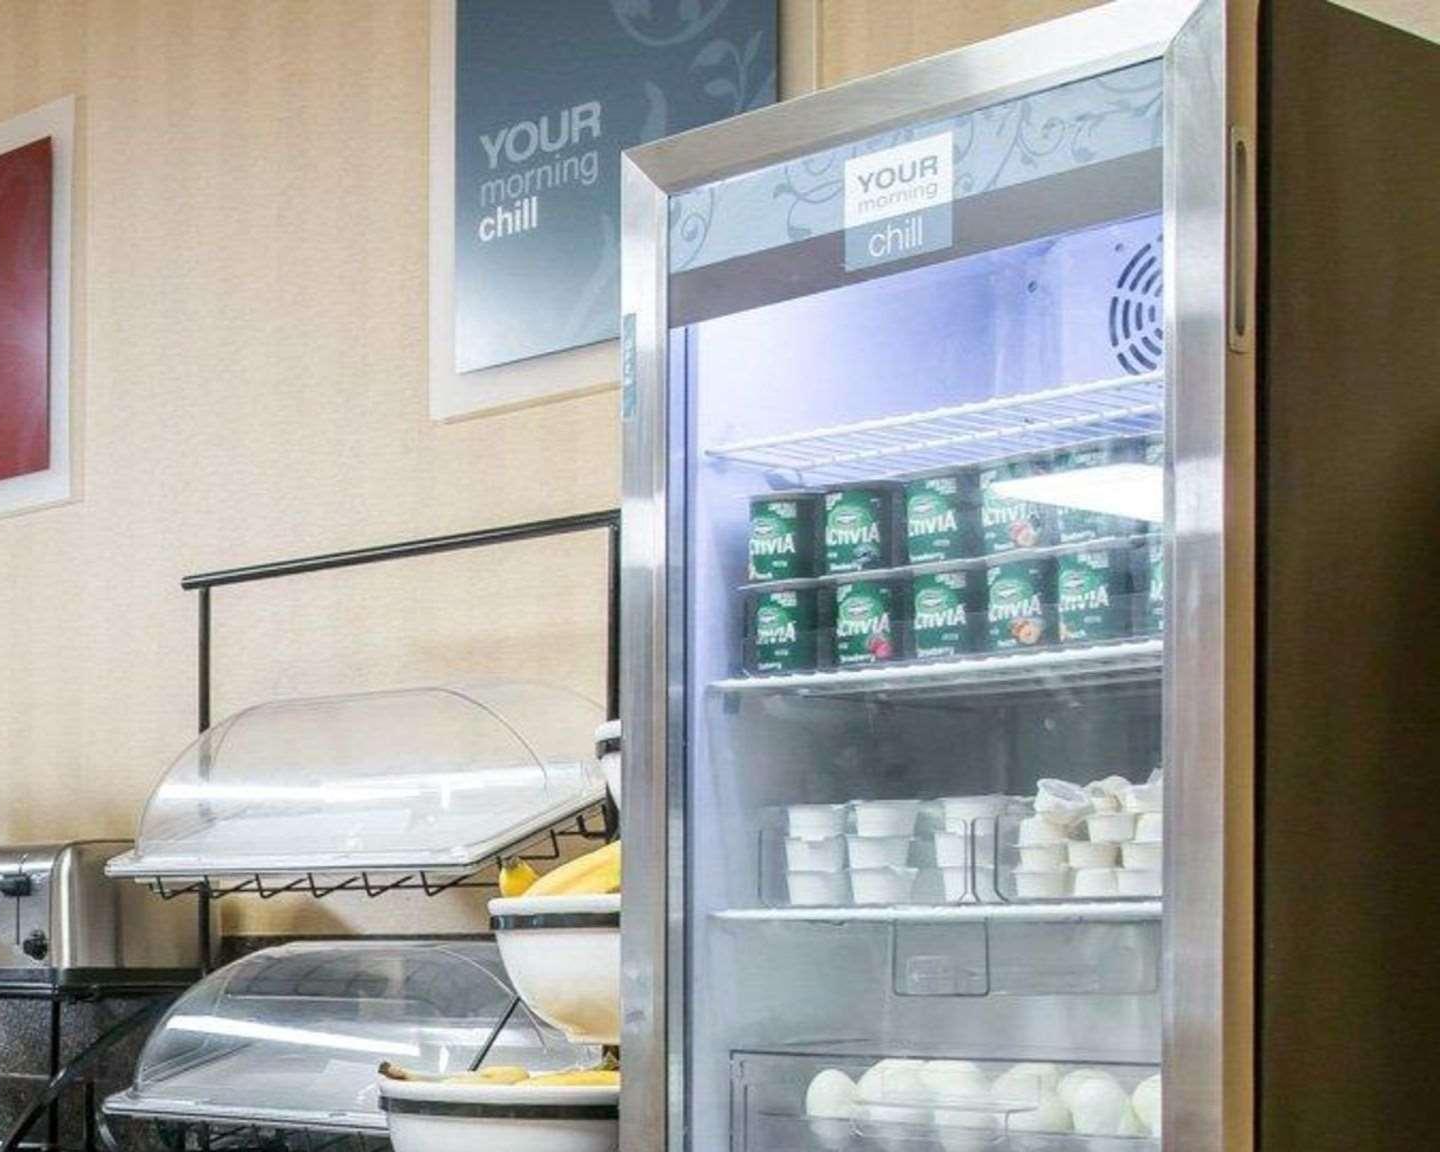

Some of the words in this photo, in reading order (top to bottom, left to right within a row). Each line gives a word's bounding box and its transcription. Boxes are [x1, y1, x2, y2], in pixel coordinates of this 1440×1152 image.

[479, 100, 602, 169] YOUR
[480, 150, 599, 207] morning
[857, 154, 939, 193] YOUR
[478, 196, 538, 242] chill
[858, 182, 938, 213] morning
[868, 216, 923, 257] chill
